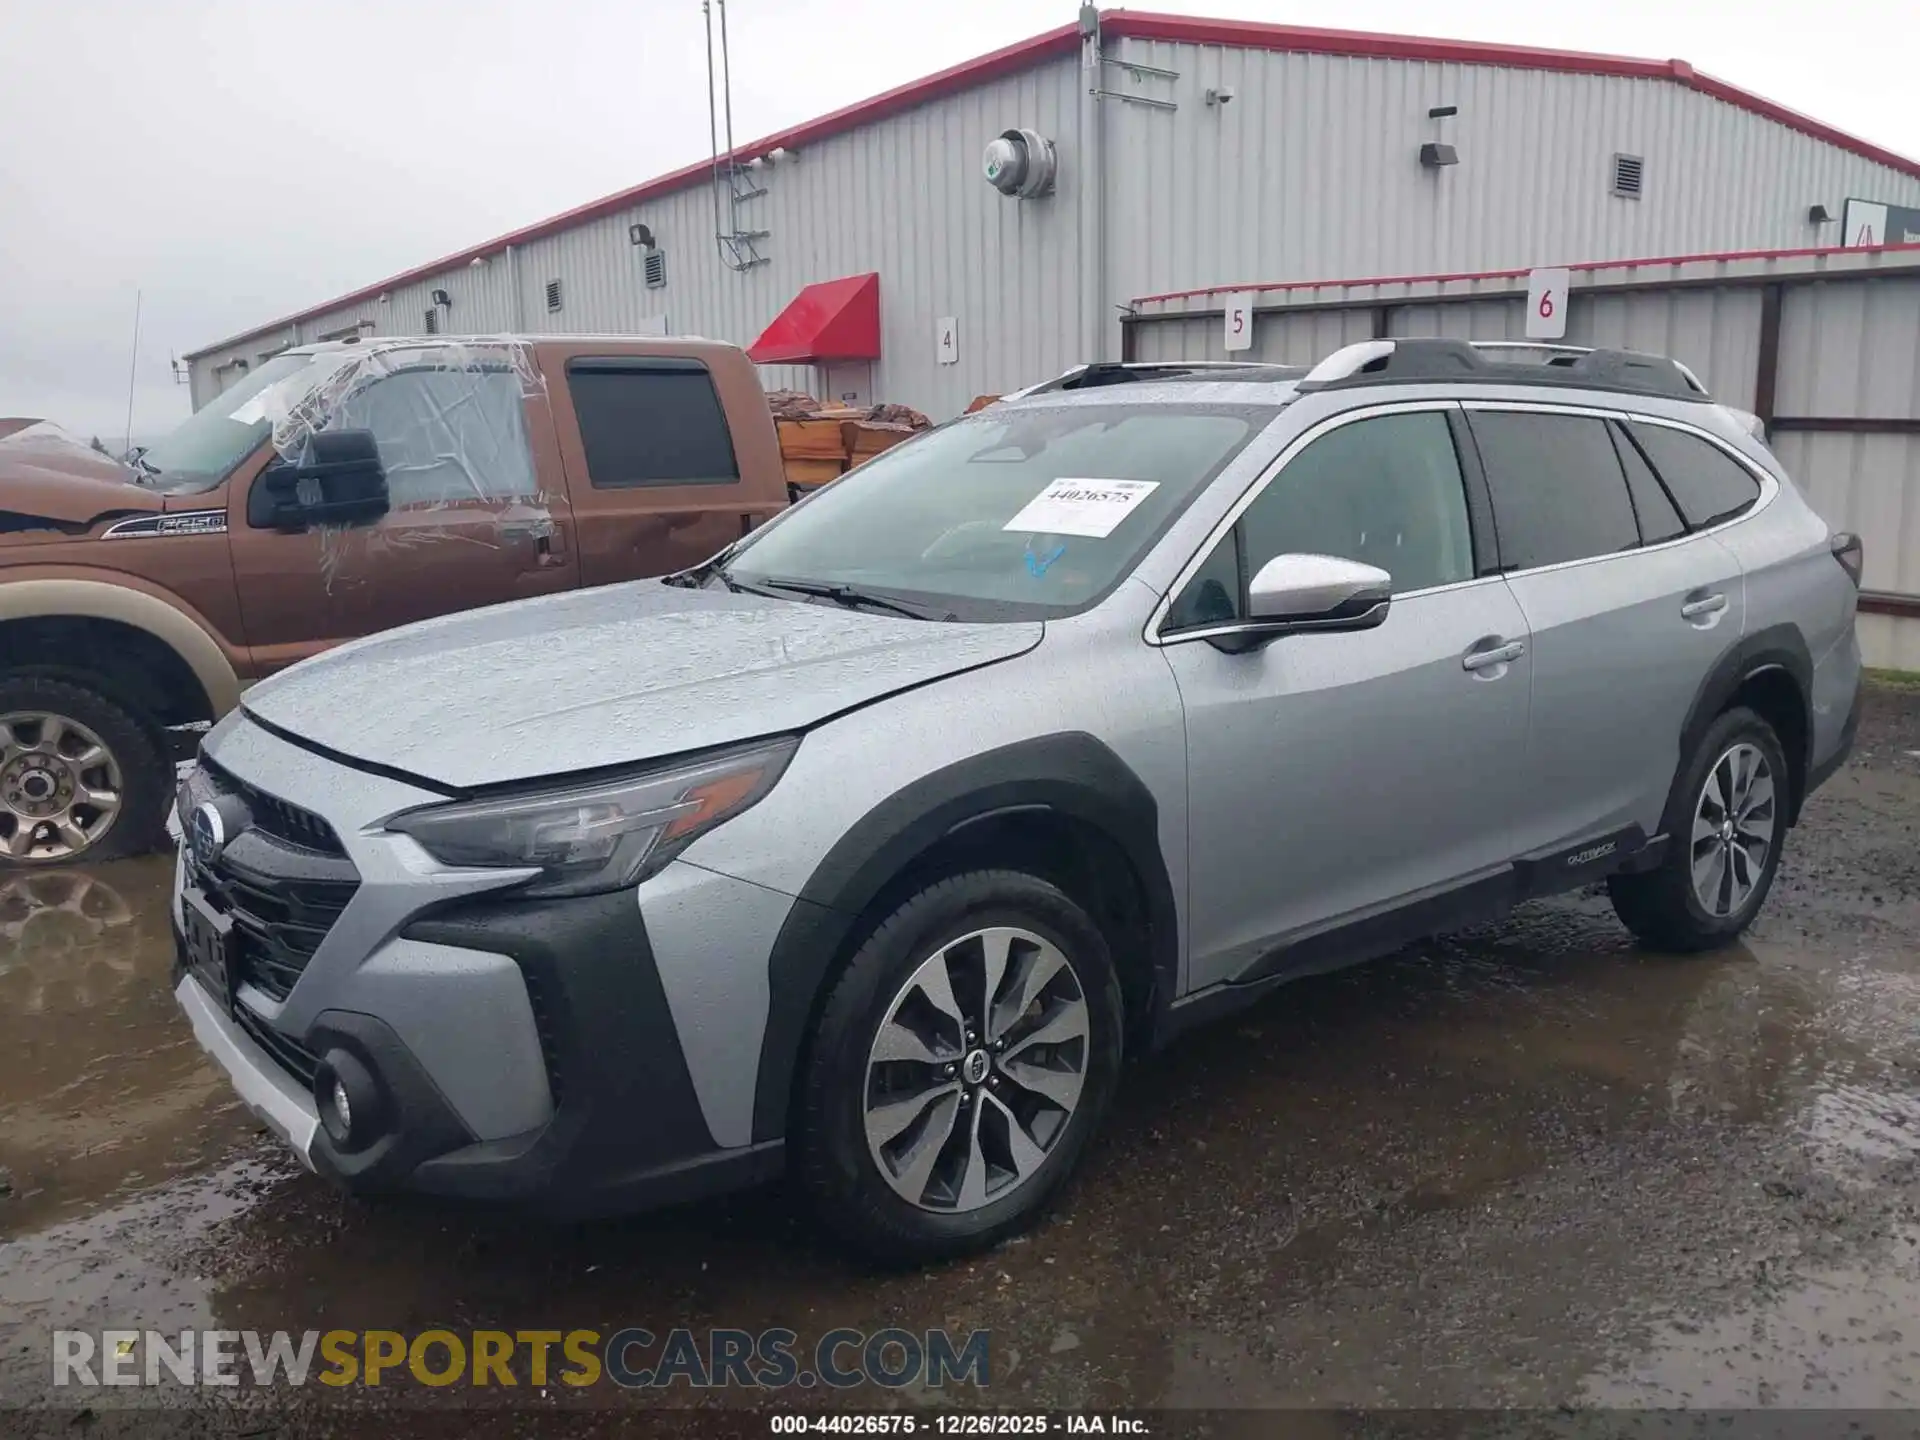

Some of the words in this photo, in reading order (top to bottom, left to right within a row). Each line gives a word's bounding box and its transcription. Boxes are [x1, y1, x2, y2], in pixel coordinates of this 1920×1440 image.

[1539, 289, 1553, 318] 6
[1233, 309, 1243, 334] 5
[943, 329, 951, 349] 4
[1047, 488, 1135, 503] 44026575
